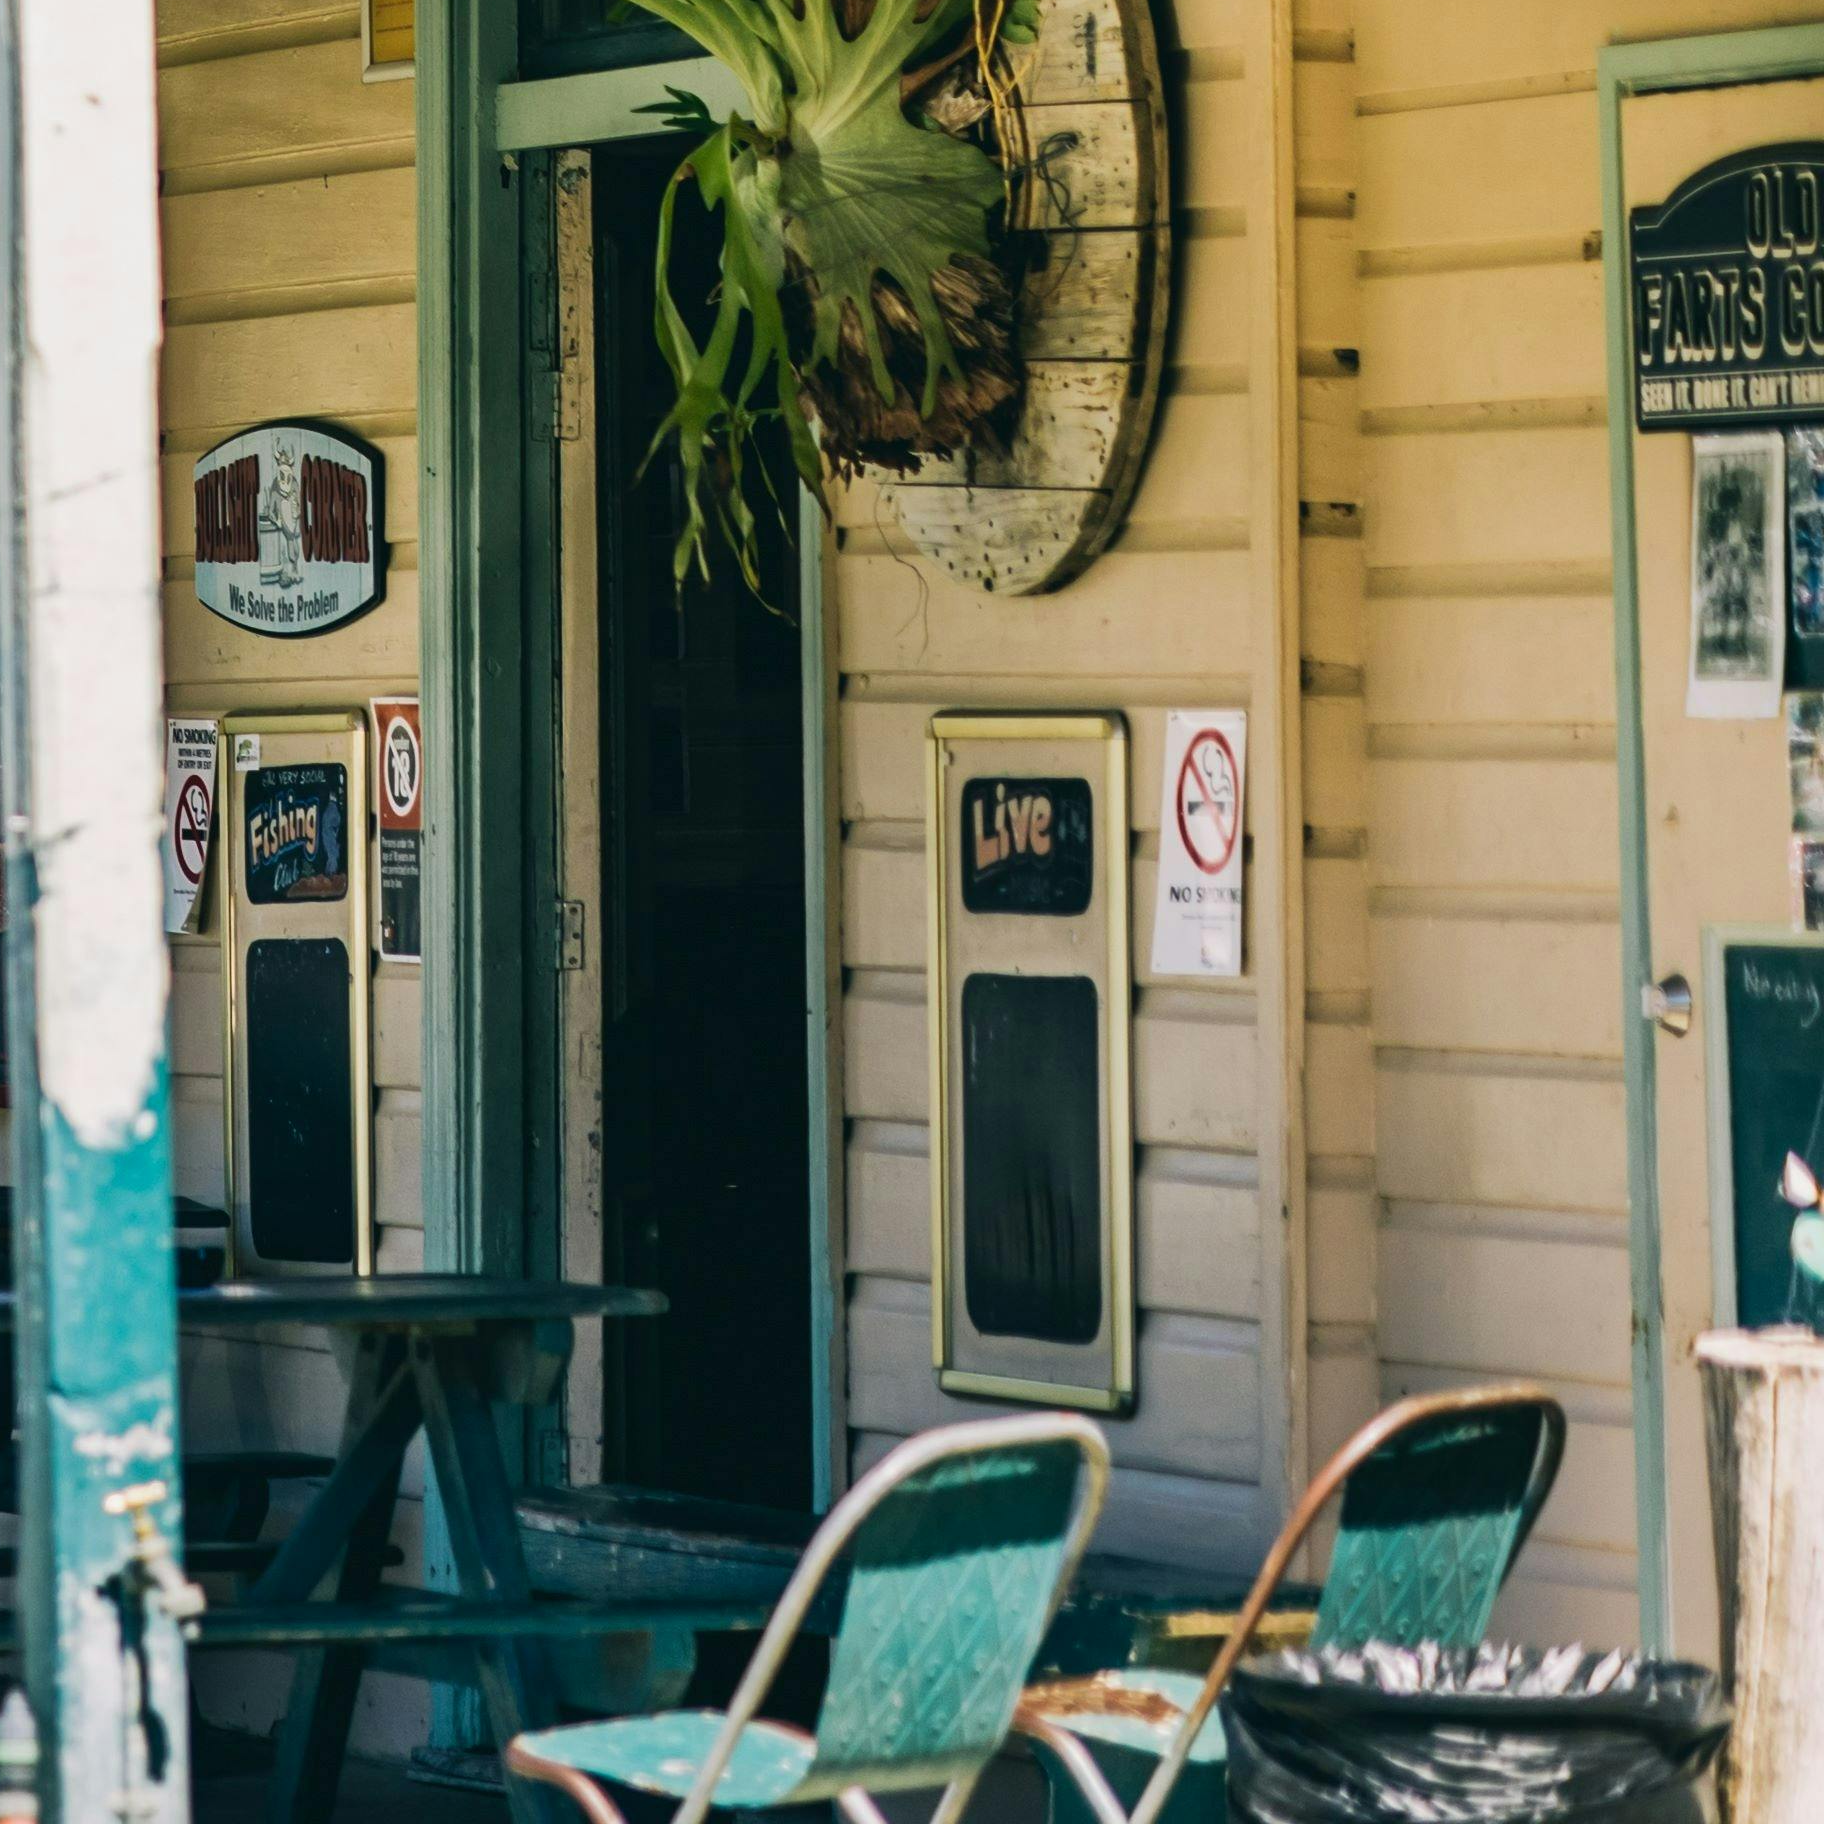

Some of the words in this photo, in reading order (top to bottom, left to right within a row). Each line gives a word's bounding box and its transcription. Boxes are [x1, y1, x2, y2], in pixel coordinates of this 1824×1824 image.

[1746, 172, 1819, 260] OLD
[1639, 267, 1766, 367] FARTS
[194, 453, 260, 564] BULLSHIT
[300, 453, 370, 564] CORNER
[229, 583, 246, 614] We
[246, 590, 276, 623] Solve
[277, 595, 295, 623] the
[297, 590, 339, 623] Problem
[173, 728, 183, 744] NO
[184, 728, 216, 745] SMOKING
[250, 794, 318, 866] Fishing
[973, 782, 1052, 871] Live
[1169, 886, 1192, 904] NO
